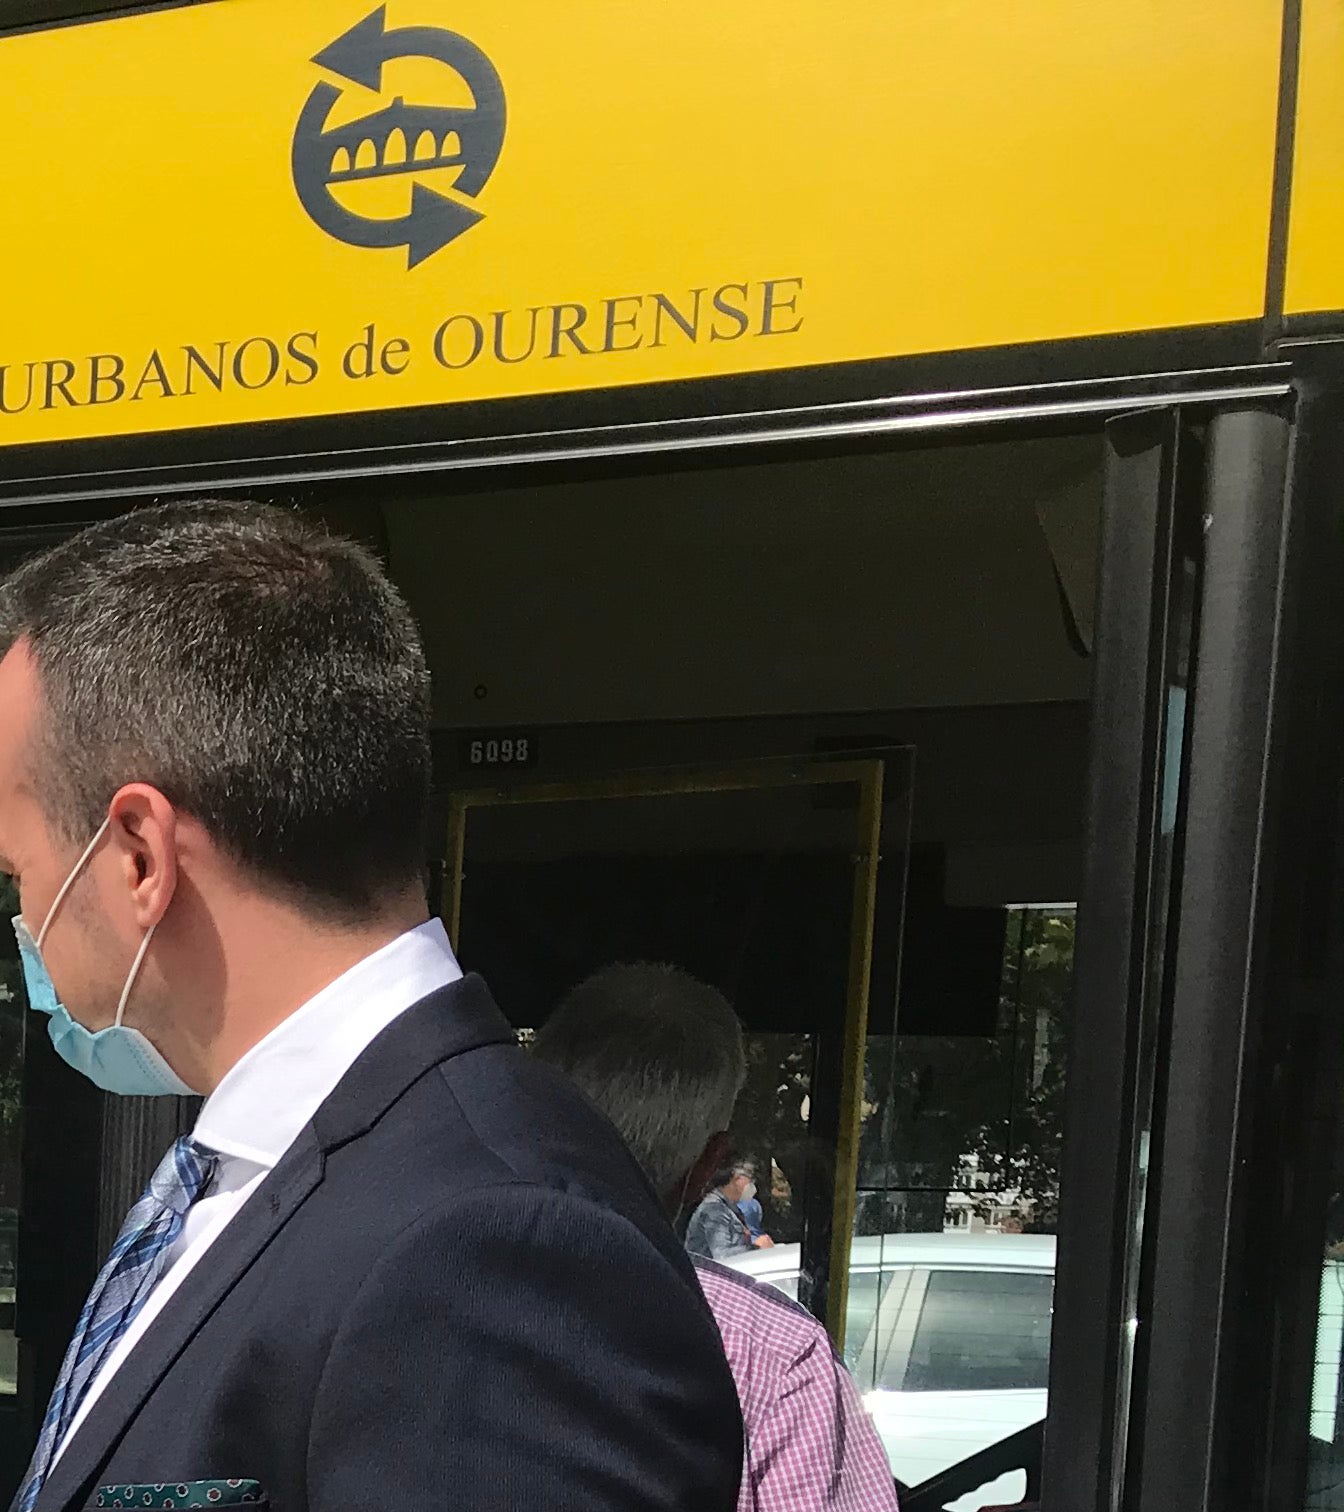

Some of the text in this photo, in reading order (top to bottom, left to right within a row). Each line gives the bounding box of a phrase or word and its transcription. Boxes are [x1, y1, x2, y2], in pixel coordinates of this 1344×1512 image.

[343, 324, 411, 380] de
[432, 278, 806, 371] OURENSE
[470, 739, 529, 764] 6098
